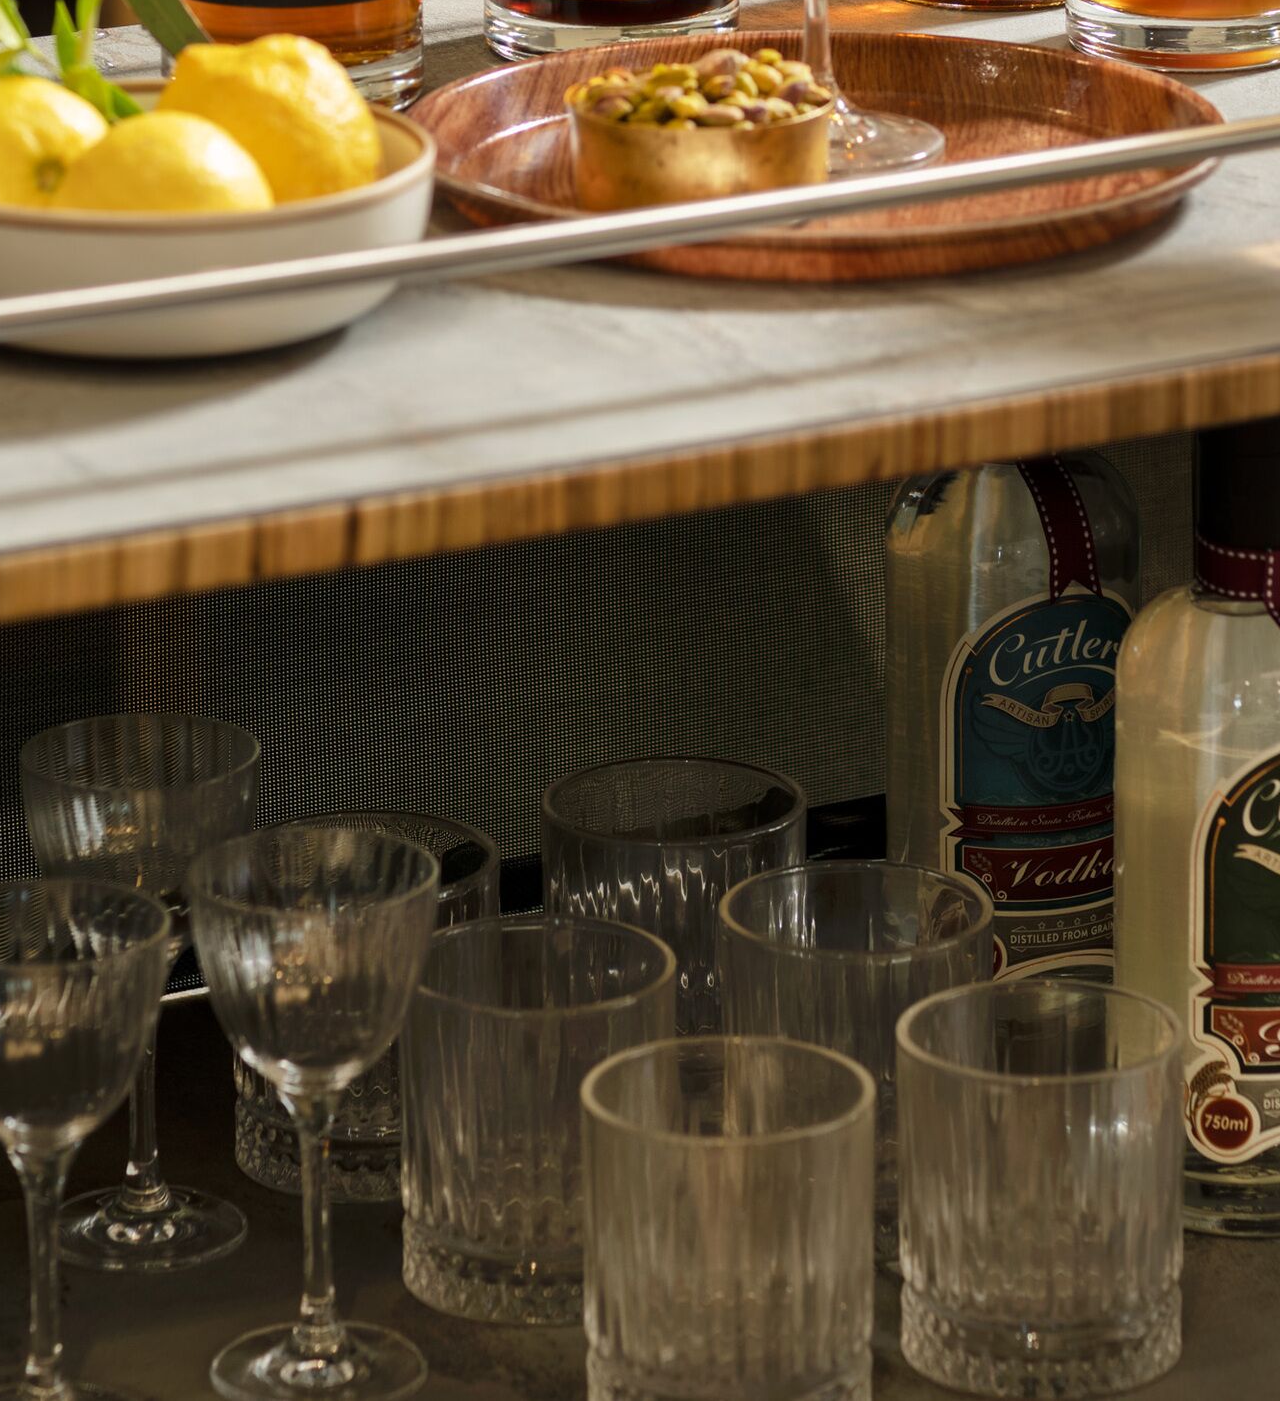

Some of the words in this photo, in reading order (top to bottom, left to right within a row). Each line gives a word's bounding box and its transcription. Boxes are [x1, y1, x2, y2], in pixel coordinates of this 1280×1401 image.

[989, 618, 1120, 686] Cutler
[999, 699, 1050, 725] ARTISAN
[1090, 697, 1110, 719] SPIR
[977, 812, 1019, 827] Distilled
[1031, 813, 1063, 826] Santa
[1010, 932, 1059, 945] DISTILLED
[1062, 927, 1089, 942] FROM
[1205, 1114, 1249, 1131] 750ml
